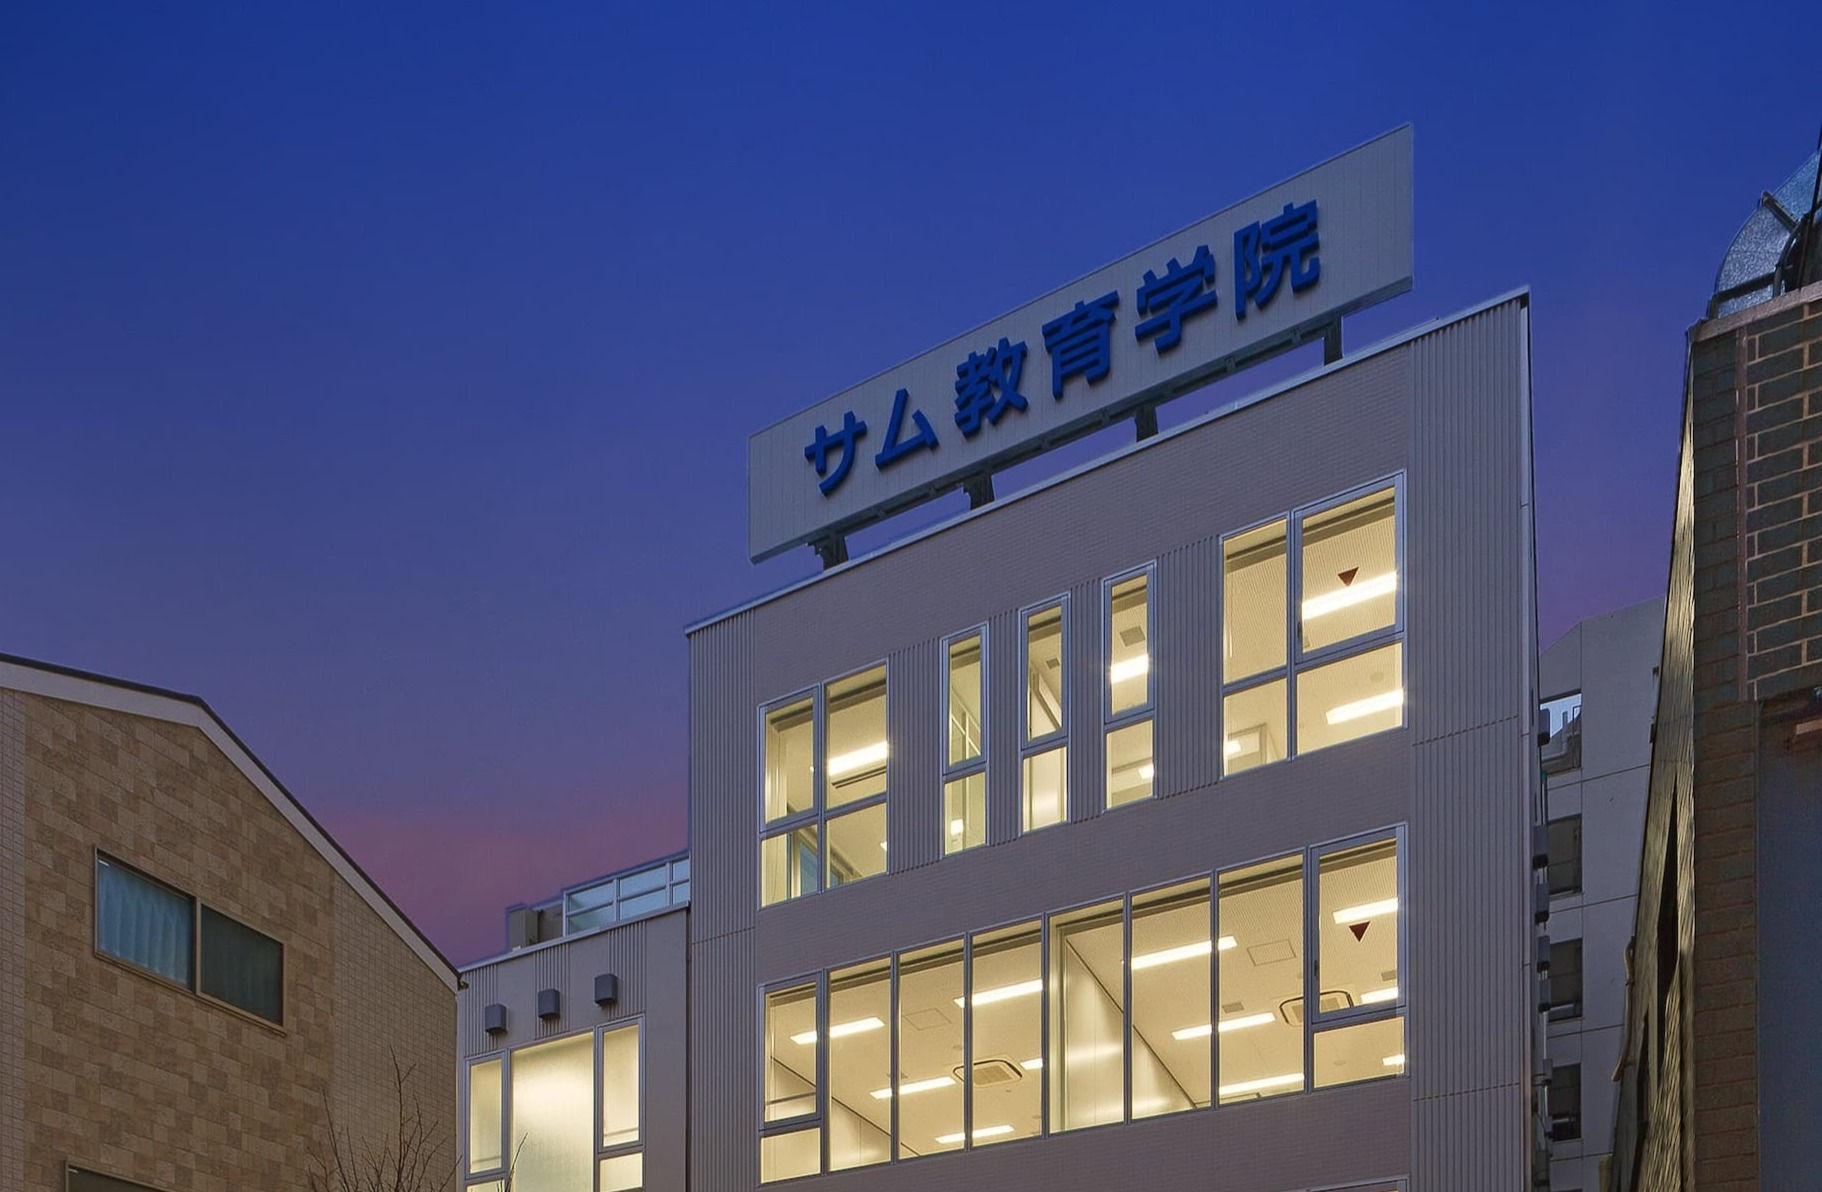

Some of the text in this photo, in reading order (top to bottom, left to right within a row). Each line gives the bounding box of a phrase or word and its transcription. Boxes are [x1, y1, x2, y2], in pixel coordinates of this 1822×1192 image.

[804, 200, 1321, 497] サム教育学院
